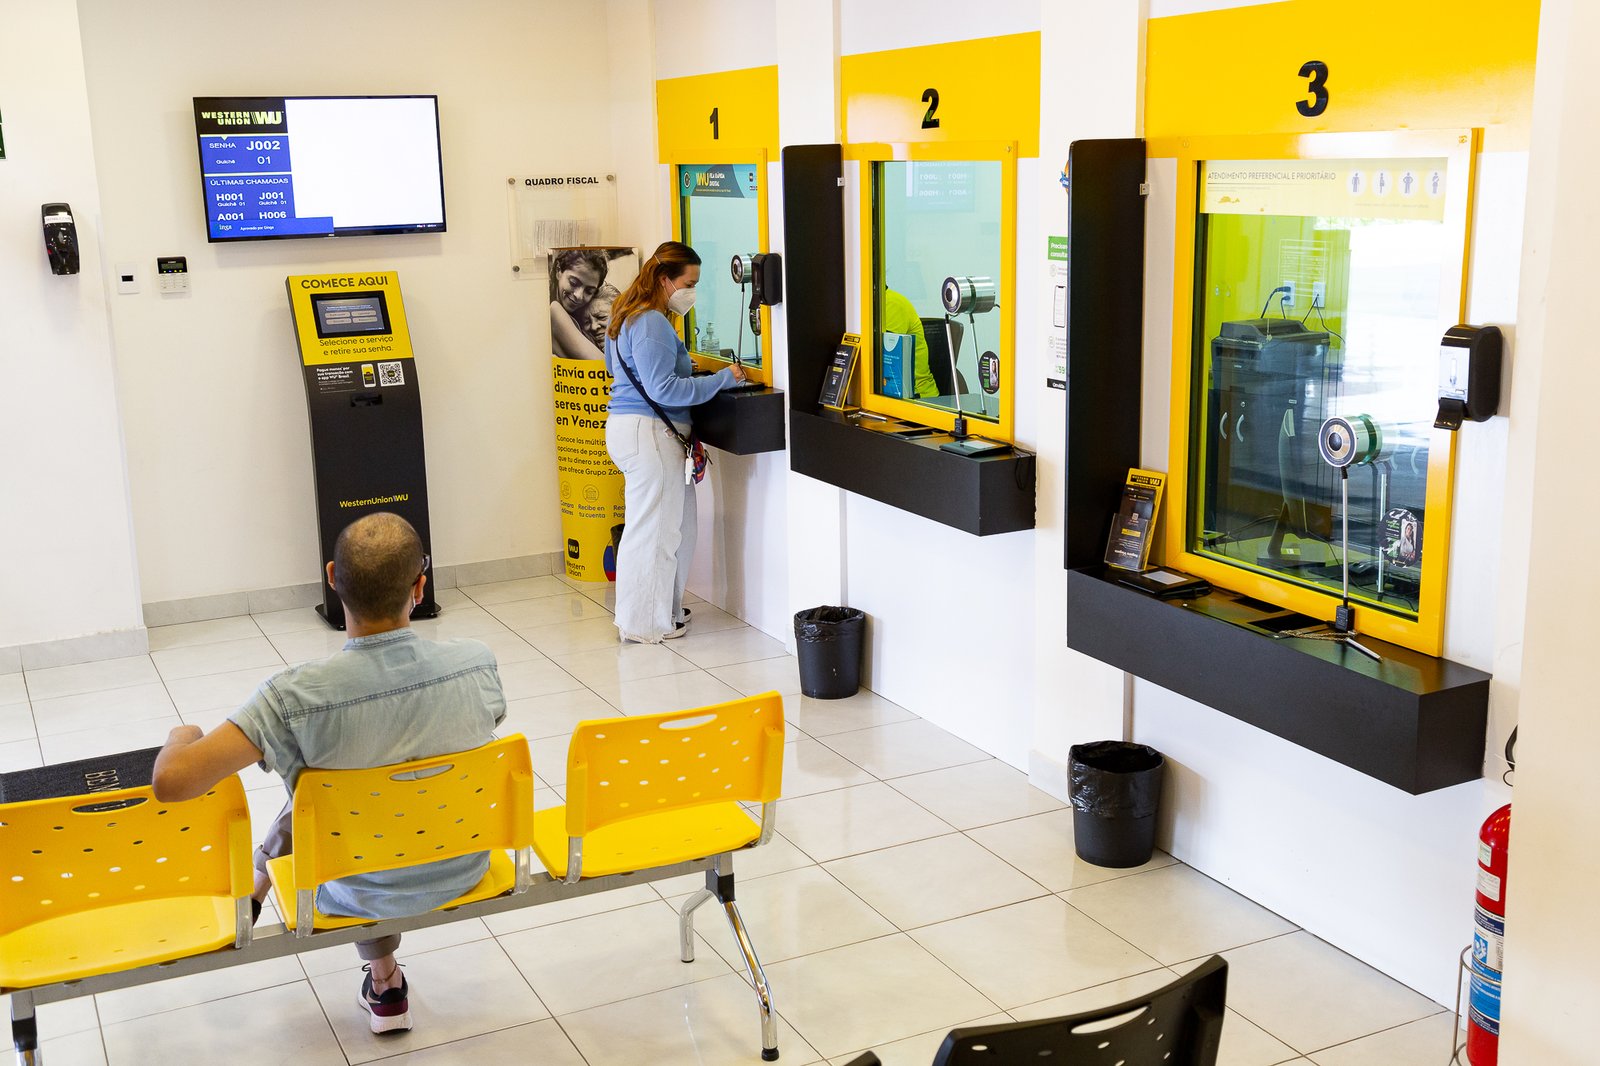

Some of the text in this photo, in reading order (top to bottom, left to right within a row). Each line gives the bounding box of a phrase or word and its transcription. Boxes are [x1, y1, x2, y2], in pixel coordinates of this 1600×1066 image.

[1296, 60, 1329, 117] 3
[921, 88, 940, 129] 2
[201, 111, 250, 119] WESTERN
[253, 111, 282, 125] WU
[709, 107, 719, 140] 1
[246, 140, 281, 151] J002
[257, 155, 271, 165] 01
[1207, 170, 1336, 180] ATENDIMENTO PREFERENCIAL E PRIORITÁRIO
[210, 177, 289, 186] ÚLTIMAS CHAMADAS
[524, 176, 599, 187] QUADRO FISCAL
[216, 191, 284, 201] H001 J001
[217, 211, 287, 221] A001 H006
[301, 276, 388, 289] COMECE AQUI
[320, 337, 358, 347] Selecione
[366, 335, 394, 343] serviço
[330, 347, 352, 355] retire
[553, 364, 614, 382] ¡Envía aqu
[554, 381, 587, 396] dinero
[590, 387, 599, 396] a
[555, 400, 607, 415] seres que
[556, 414, 607, 429] en Venez
[557, 435, 575, 443] Conoce
[585, 438, 607, 447] múltip
[557, 445, 580, 454] opciones
[589, 449, 607, 458] pago
[574, 457, 592, 465] dinero
[568, 466, 585, 474] ofrece
[585, 467, 607, 477] Grupo
[608, 468, 624, 476] Zoo
[339, 495, 394, 508] WesternUnion
[568, 544, 579, 553] WU
[566, 560, 586, 570] Western
